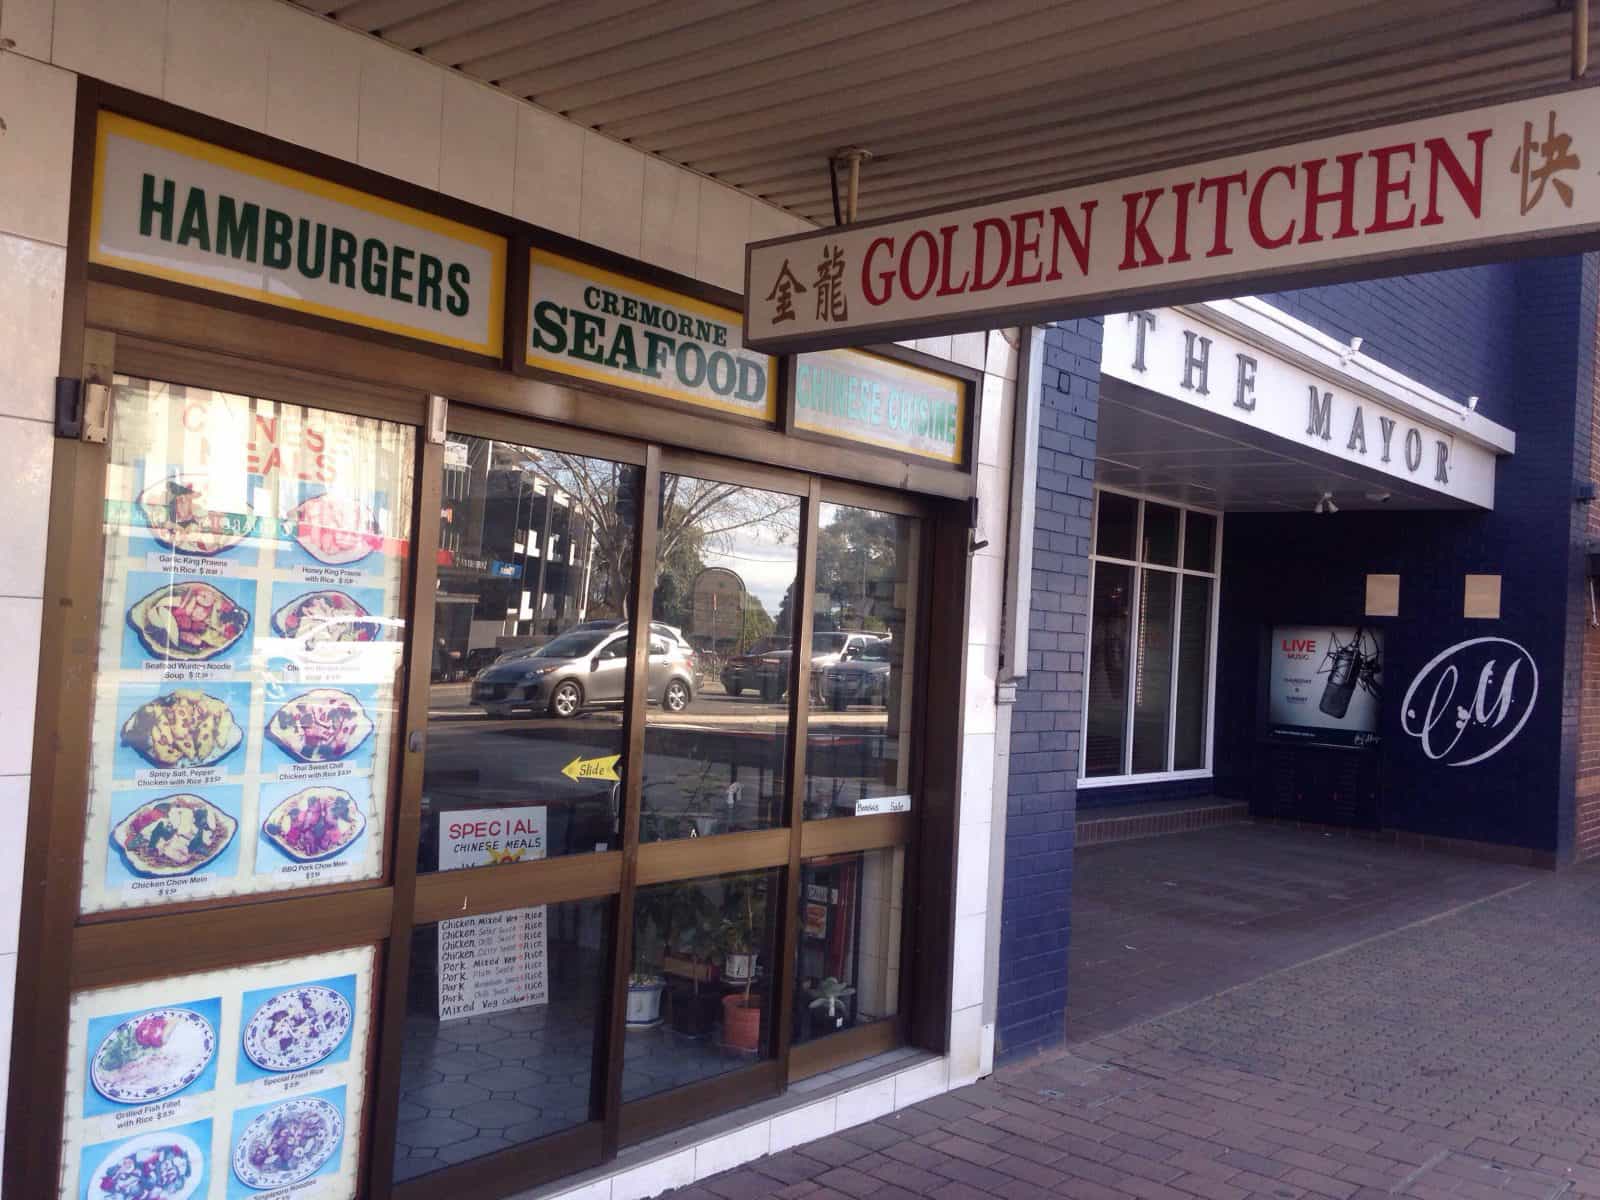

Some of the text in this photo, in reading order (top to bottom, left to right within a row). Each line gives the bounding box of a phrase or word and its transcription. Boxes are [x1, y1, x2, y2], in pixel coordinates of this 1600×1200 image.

[765, 244, 848, 325] 金龍
[861, 200, 1096, 307] GOLDEN
[1118, 128, 1491, 272] KITCHEN
[139, 172, 470, 318] HAMBURGERS
[584, 285, 727, 346] CREMORNE
[532, 300, 766, 403] SEAFOOD
[797, 364, 957, 445] CHINESE CUISINE
[1128, 311, 1452, 485] THE MAYOR
[1281, 639, 1317, 653] LIVE
[579, 763, 606, 777] Slide
[448, 818, 539, 840] SPECIAL
[454, 837, 541, 854] CHINESE MEALS
[442, 918, 475, 930] Chicken
[525, 911, 543, 920] Rice
[442, 929, 475, 940] Chicken
[525, 922, 543, 931] Rice
[442, 940, 475, 951] Chicken
[524, 931, 542, 940] Rice
[442, 950, 474, 961] Chicken
[524, 941, 543, 950] Rice
[442, 972, 467, 983] Pork
[525, 961, 543, 970] Rice
[443, 961, 466, 973] Pork
[524, 950, 543, 960] Rice
[442, 982, 465, 994] Pork
[525, 972, 543, 981] Rice
[442, 992, 464, 1004] Pork
[442, 1001, 475, 1017] Mixed
